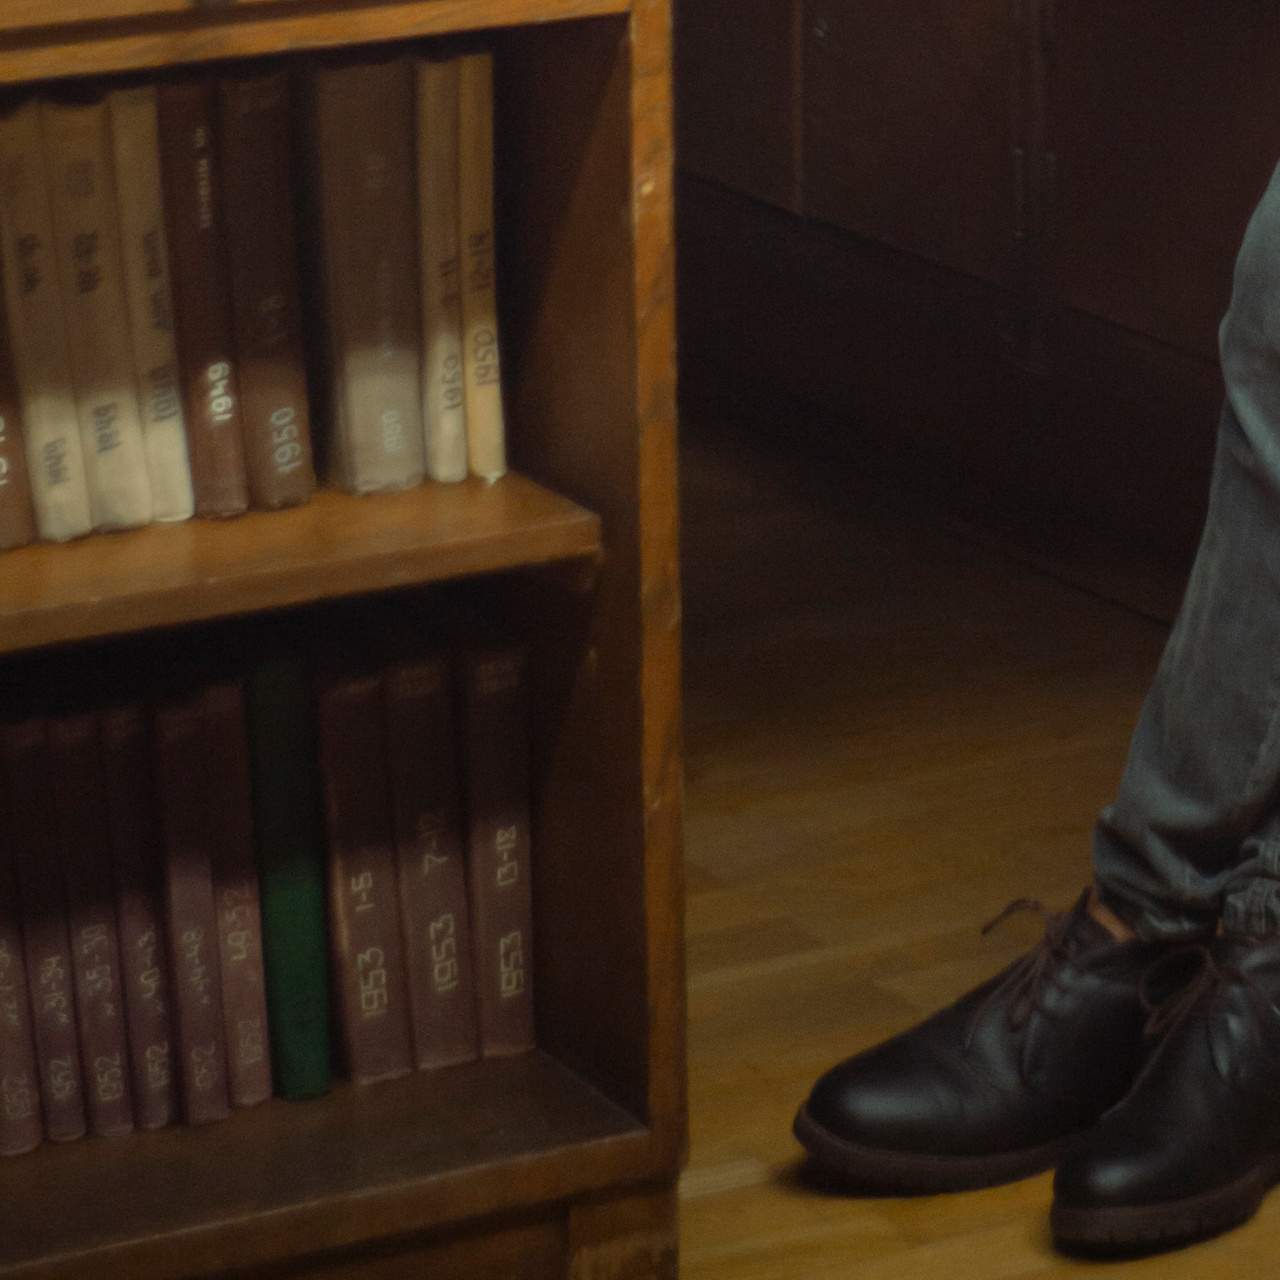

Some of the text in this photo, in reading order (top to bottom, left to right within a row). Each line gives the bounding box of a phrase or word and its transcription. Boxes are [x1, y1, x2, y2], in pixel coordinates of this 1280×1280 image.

[203, 360, 238, 426] 1949
[473, 328, 499, 388] 1950
[269, 405, 301, 474] 1950
[495, 825, 525, 998] 1953 13-18
[356, 945, 388, 1019] 1953
[428, 913, 459, 993] 1953
